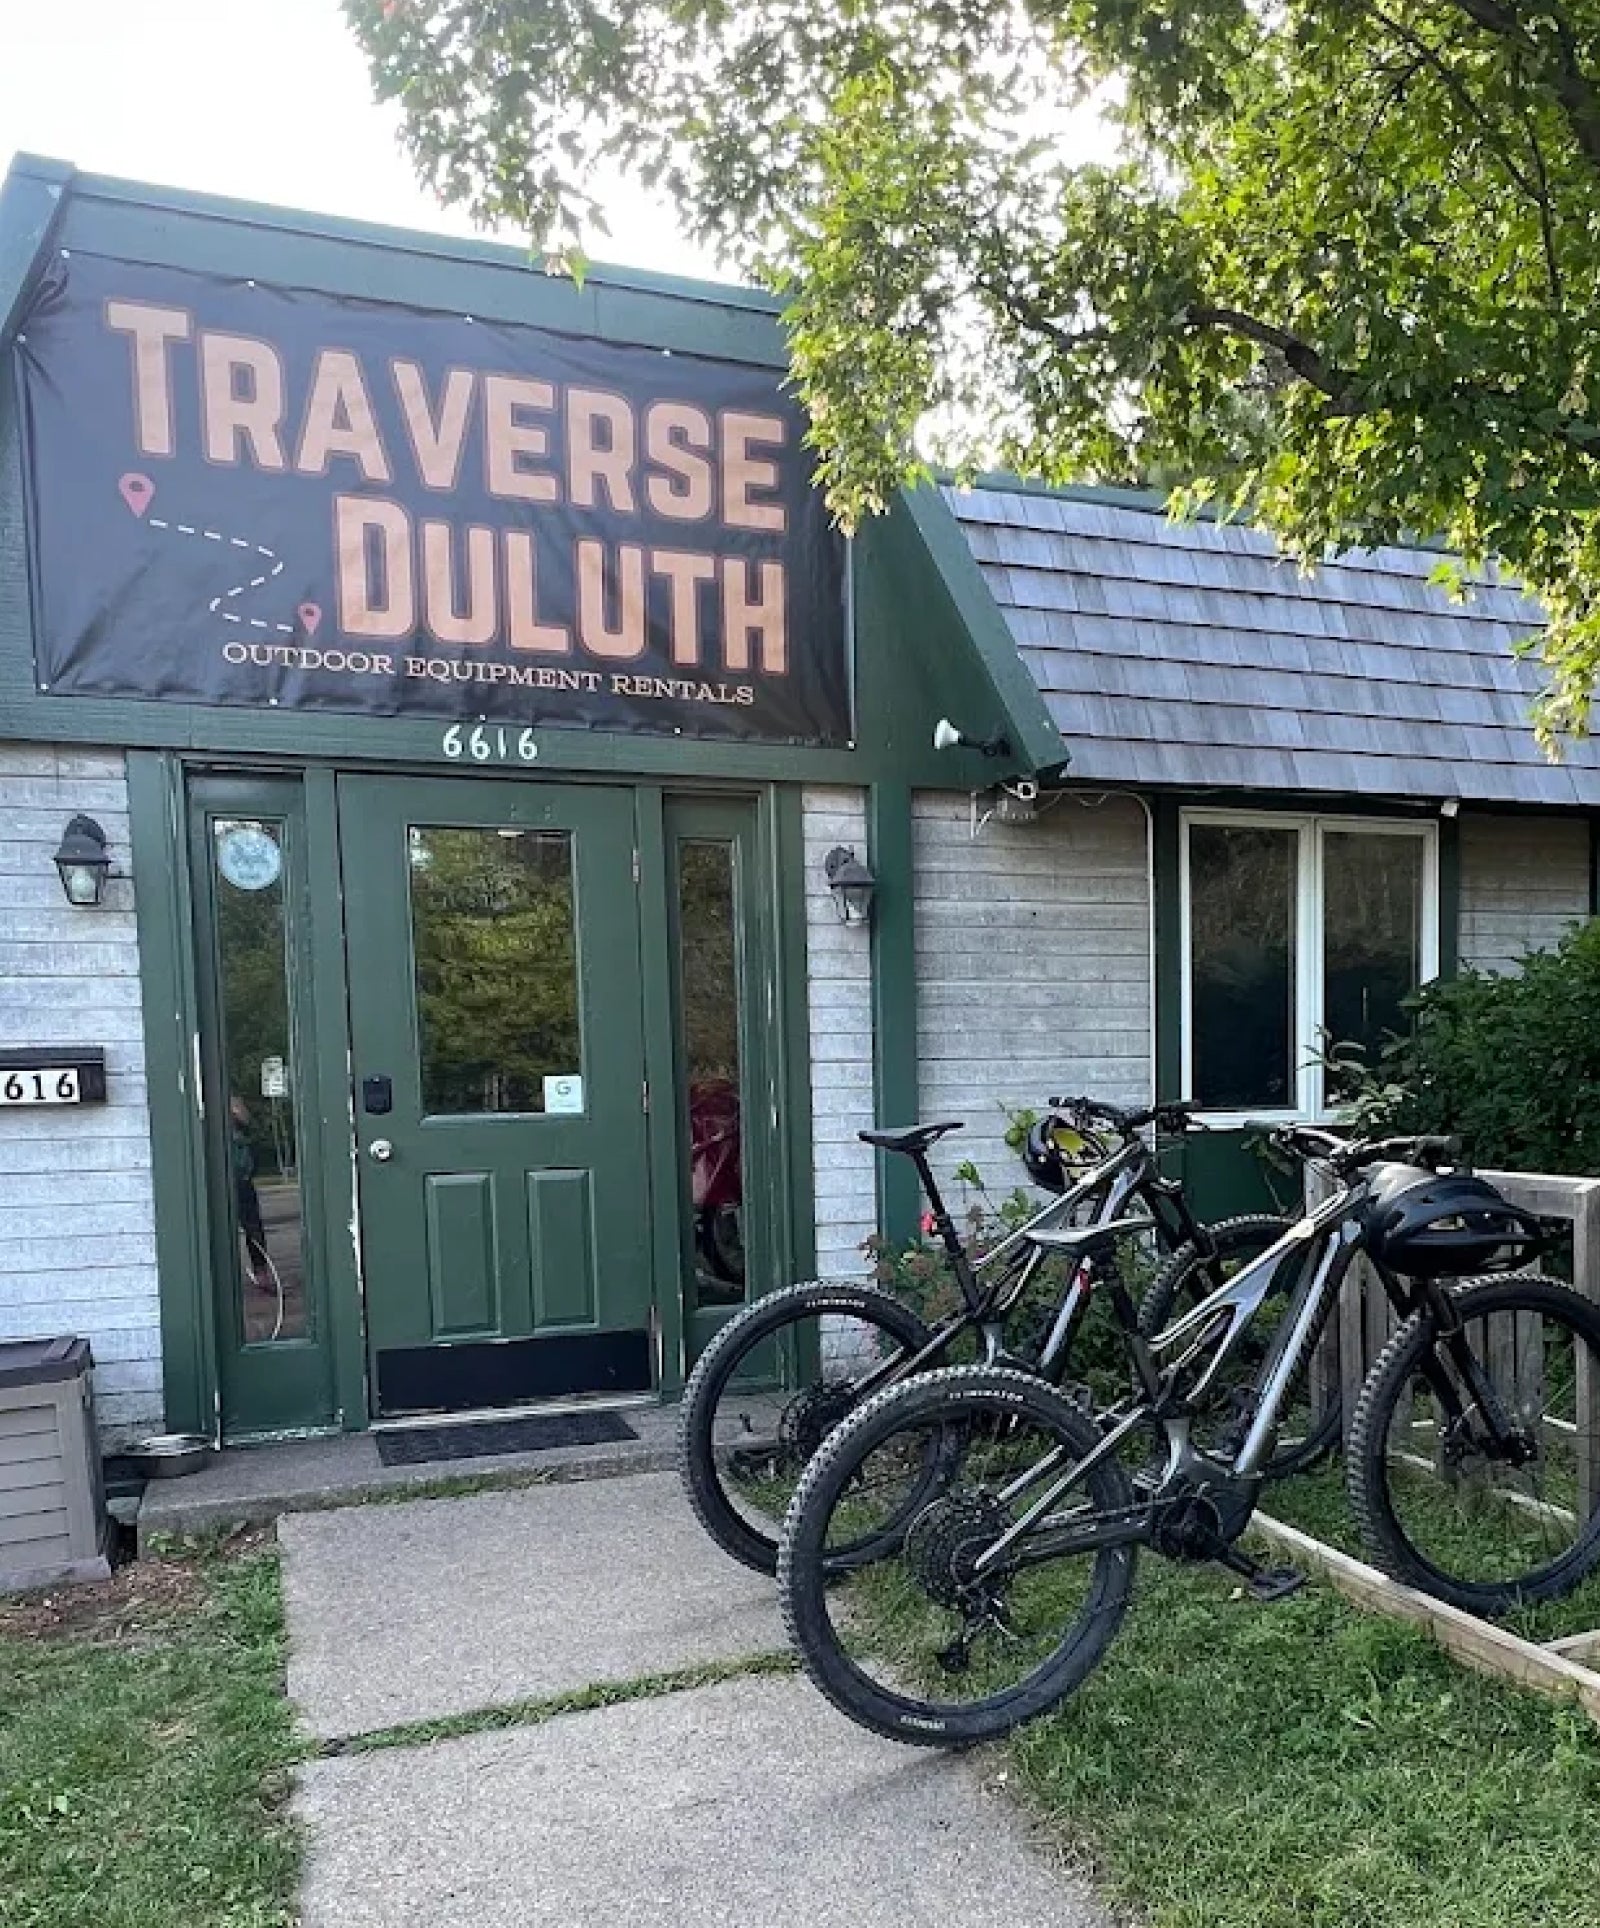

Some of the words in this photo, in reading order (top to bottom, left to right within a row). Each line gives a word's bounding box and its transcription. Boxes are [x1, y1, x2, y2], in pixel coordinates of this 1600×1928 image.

[106, 300, 787, 532] TRAVERSE
[336, 495, 787, 674] DULUTH
[222, 641, 395, 674] OUTDOOR
[405, 656, 602, 693] EQUIPMENT
[610, 673, 754, 706] RENTALS
[442, 723, 538, 760] 6616
[3, 1072, 75, 1100] 616
